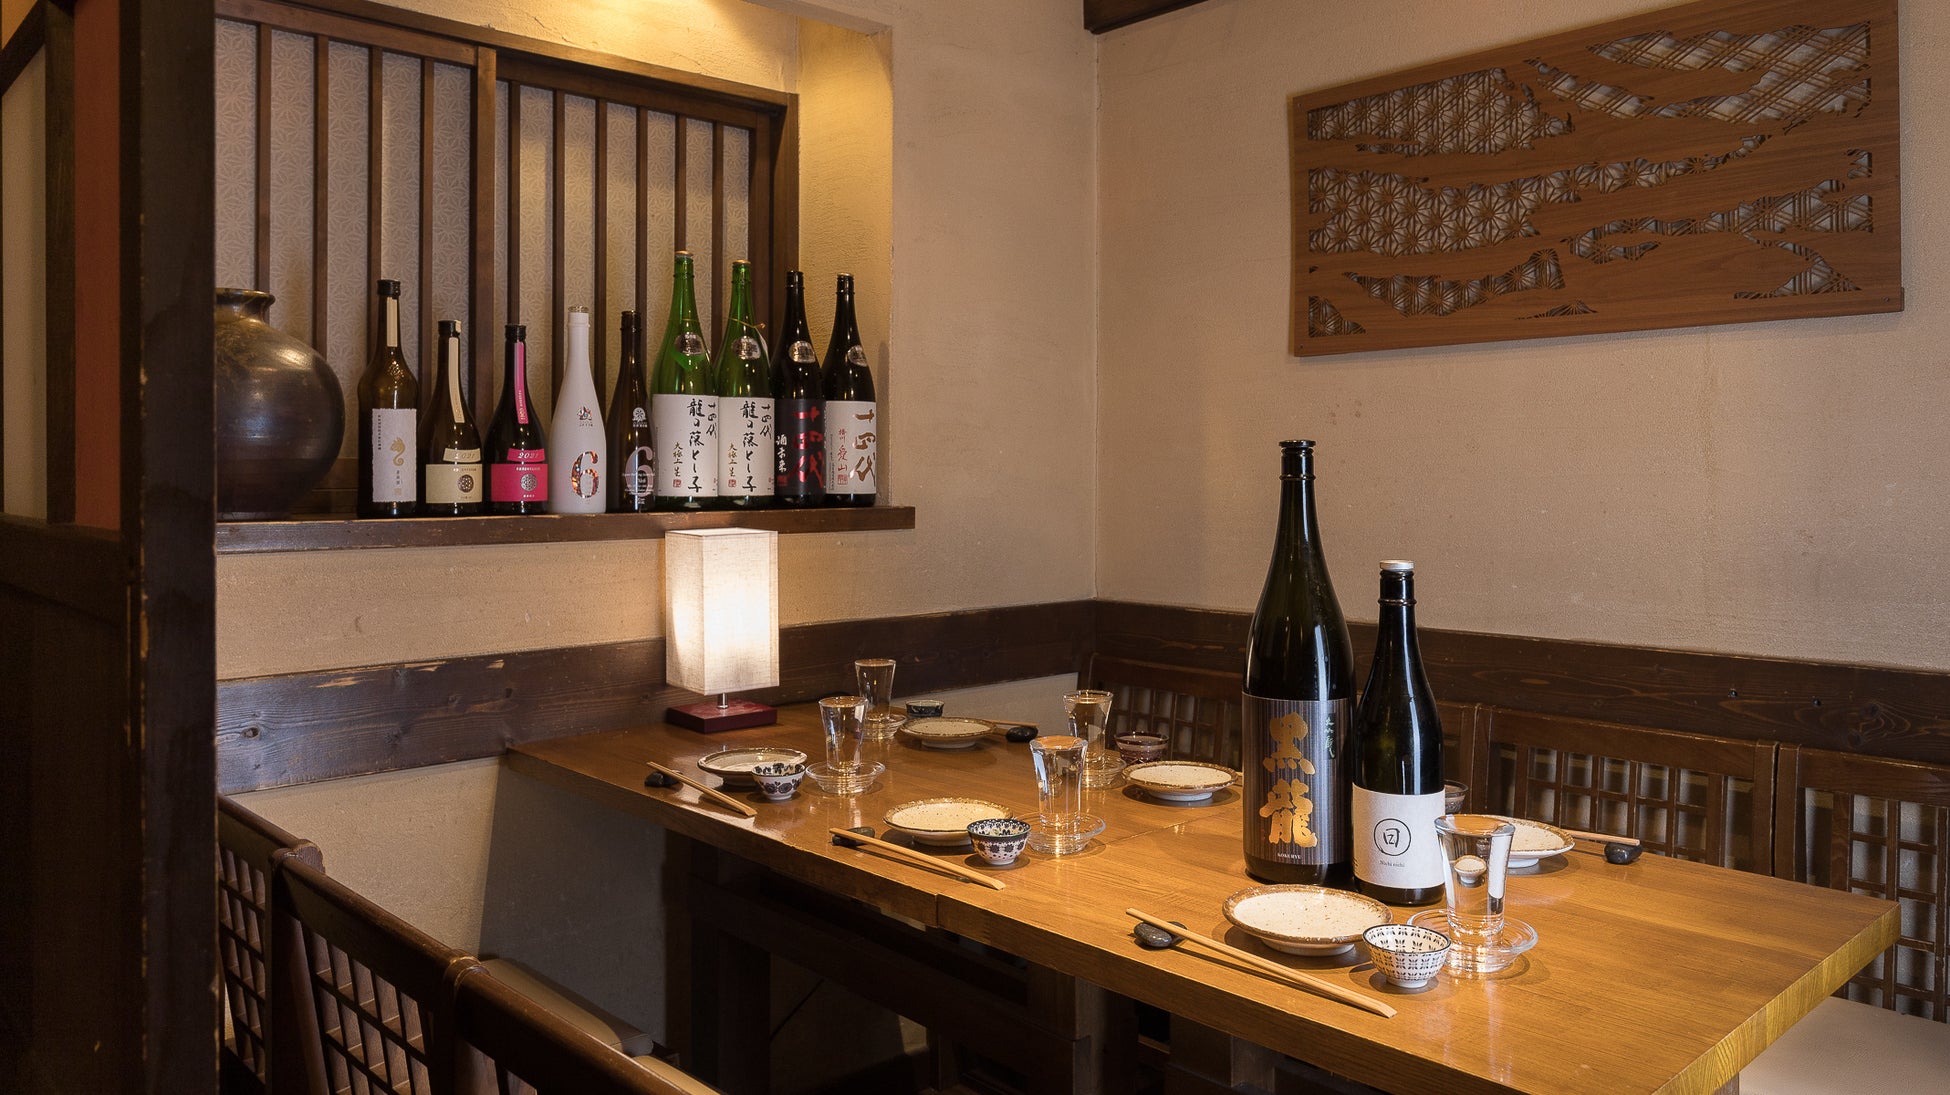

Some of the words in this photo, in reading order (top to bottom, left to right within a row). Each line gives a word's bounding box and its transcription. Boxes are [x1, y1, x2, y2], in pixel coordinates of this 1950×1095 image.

[687, 398, 705, 492] 龍の落とし子
[705, 402, 717, 438] 十四代
[740, 401, 759, 492] 龍の落とし子
[760, 404, 772, 439] 十四代
[788, 406, 824, 488] 十四代
[850, 409, 876, 487] 十四代
[571, 451, 599, 499] 6
[625, 446, 654, 497] 6
[1259, 712, 1318, 848] 黒龍
